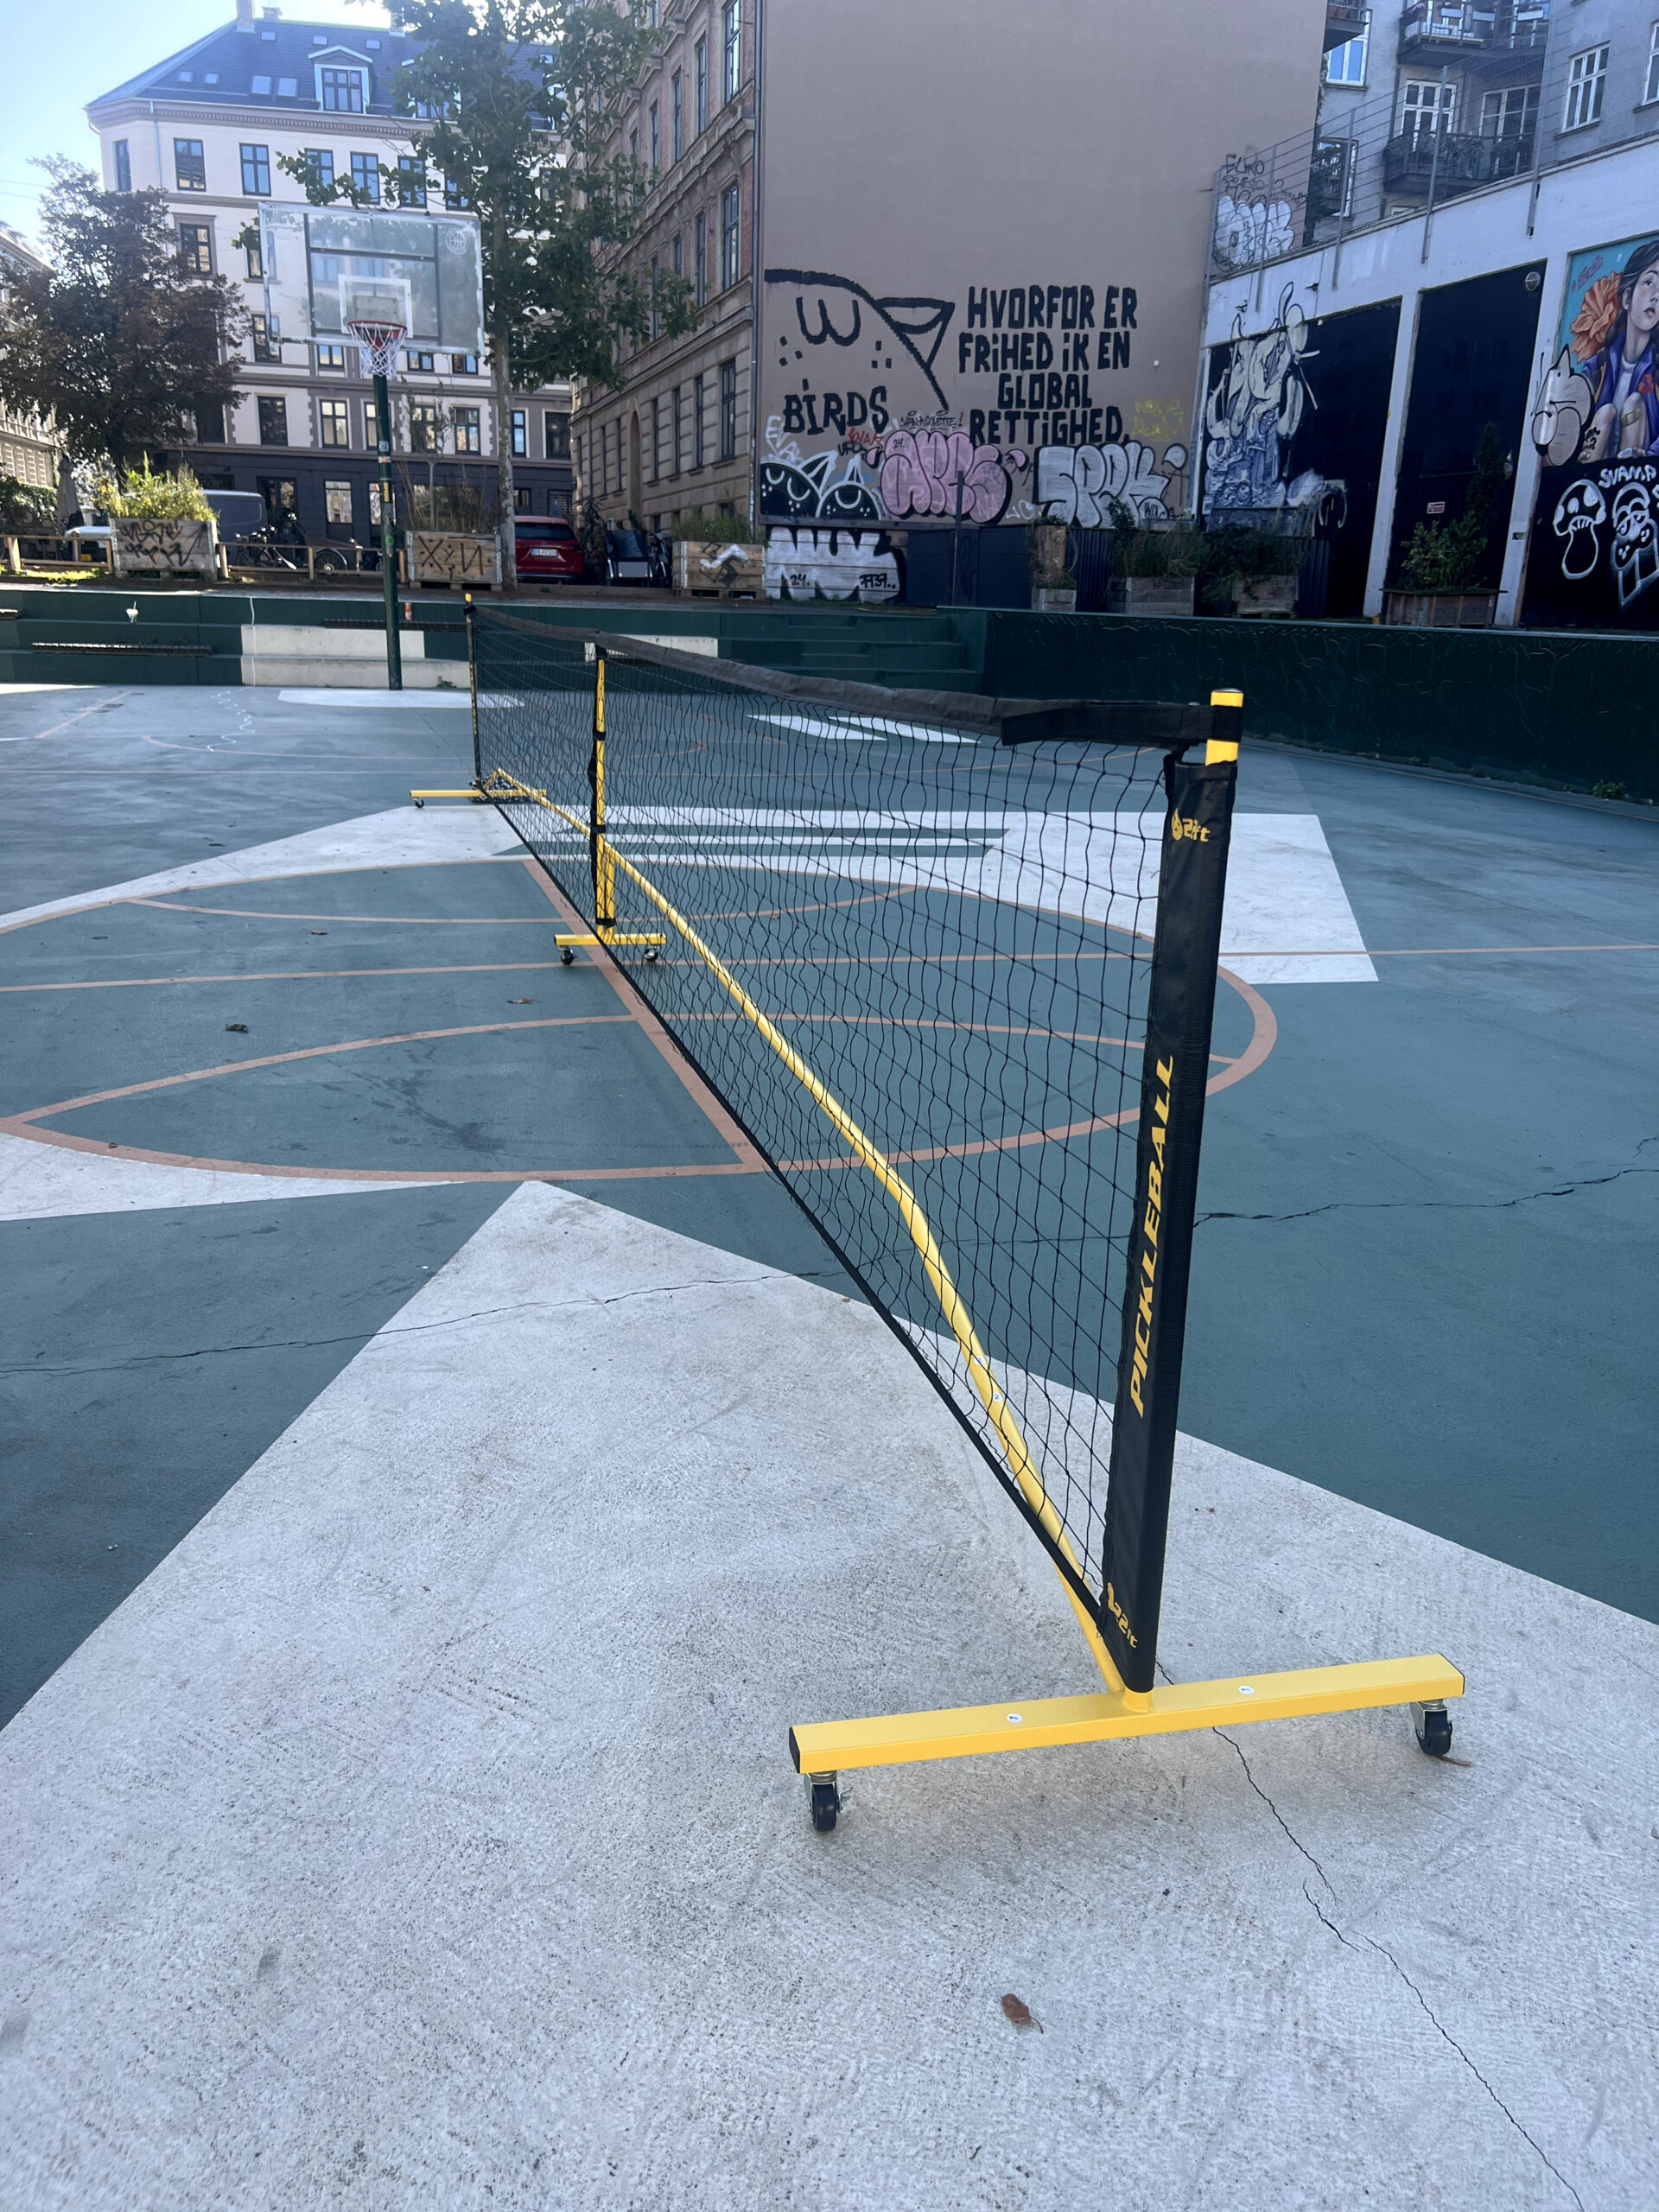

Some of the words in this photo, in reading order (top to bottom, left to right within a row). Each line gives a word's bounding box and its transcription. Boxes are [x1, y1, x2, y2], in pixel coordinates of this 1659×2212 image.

[967, 285, 1095, 329] HVORFOR
[1103, 286, 1138, 329] ER
[1098, 332, 1130, 370] EN
[783, 378, 889, 436] BIRDS
[998, 373, 1093, 410] GLOBAL
[1129, 1053, 1174, 1420] PICKLEBALL
